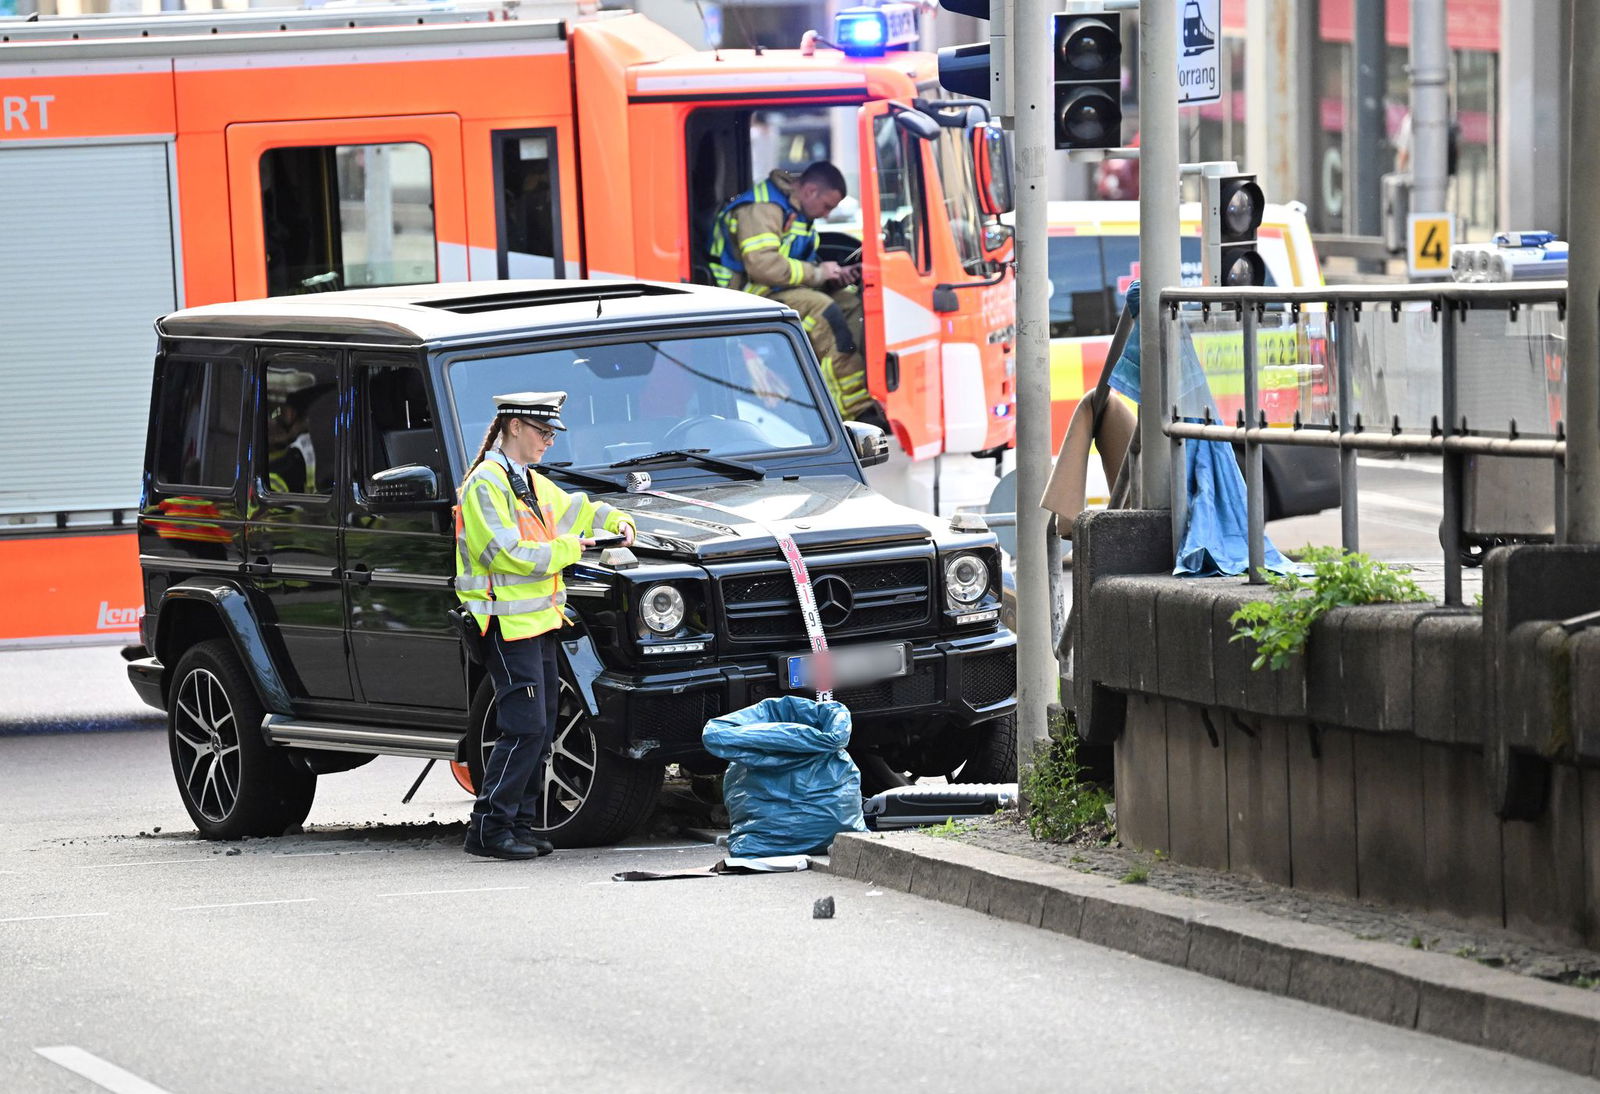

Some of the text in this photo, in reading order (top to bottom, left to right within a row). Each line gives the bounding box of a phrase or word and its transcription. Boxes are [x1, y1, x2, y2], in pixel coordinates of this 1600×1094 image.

[1177, 64, 1216, 90] orrang
[4, 95, 56, 131] RT
[1420, 225, 1444, 263] 4
[808, 611, 816, 627] 9
